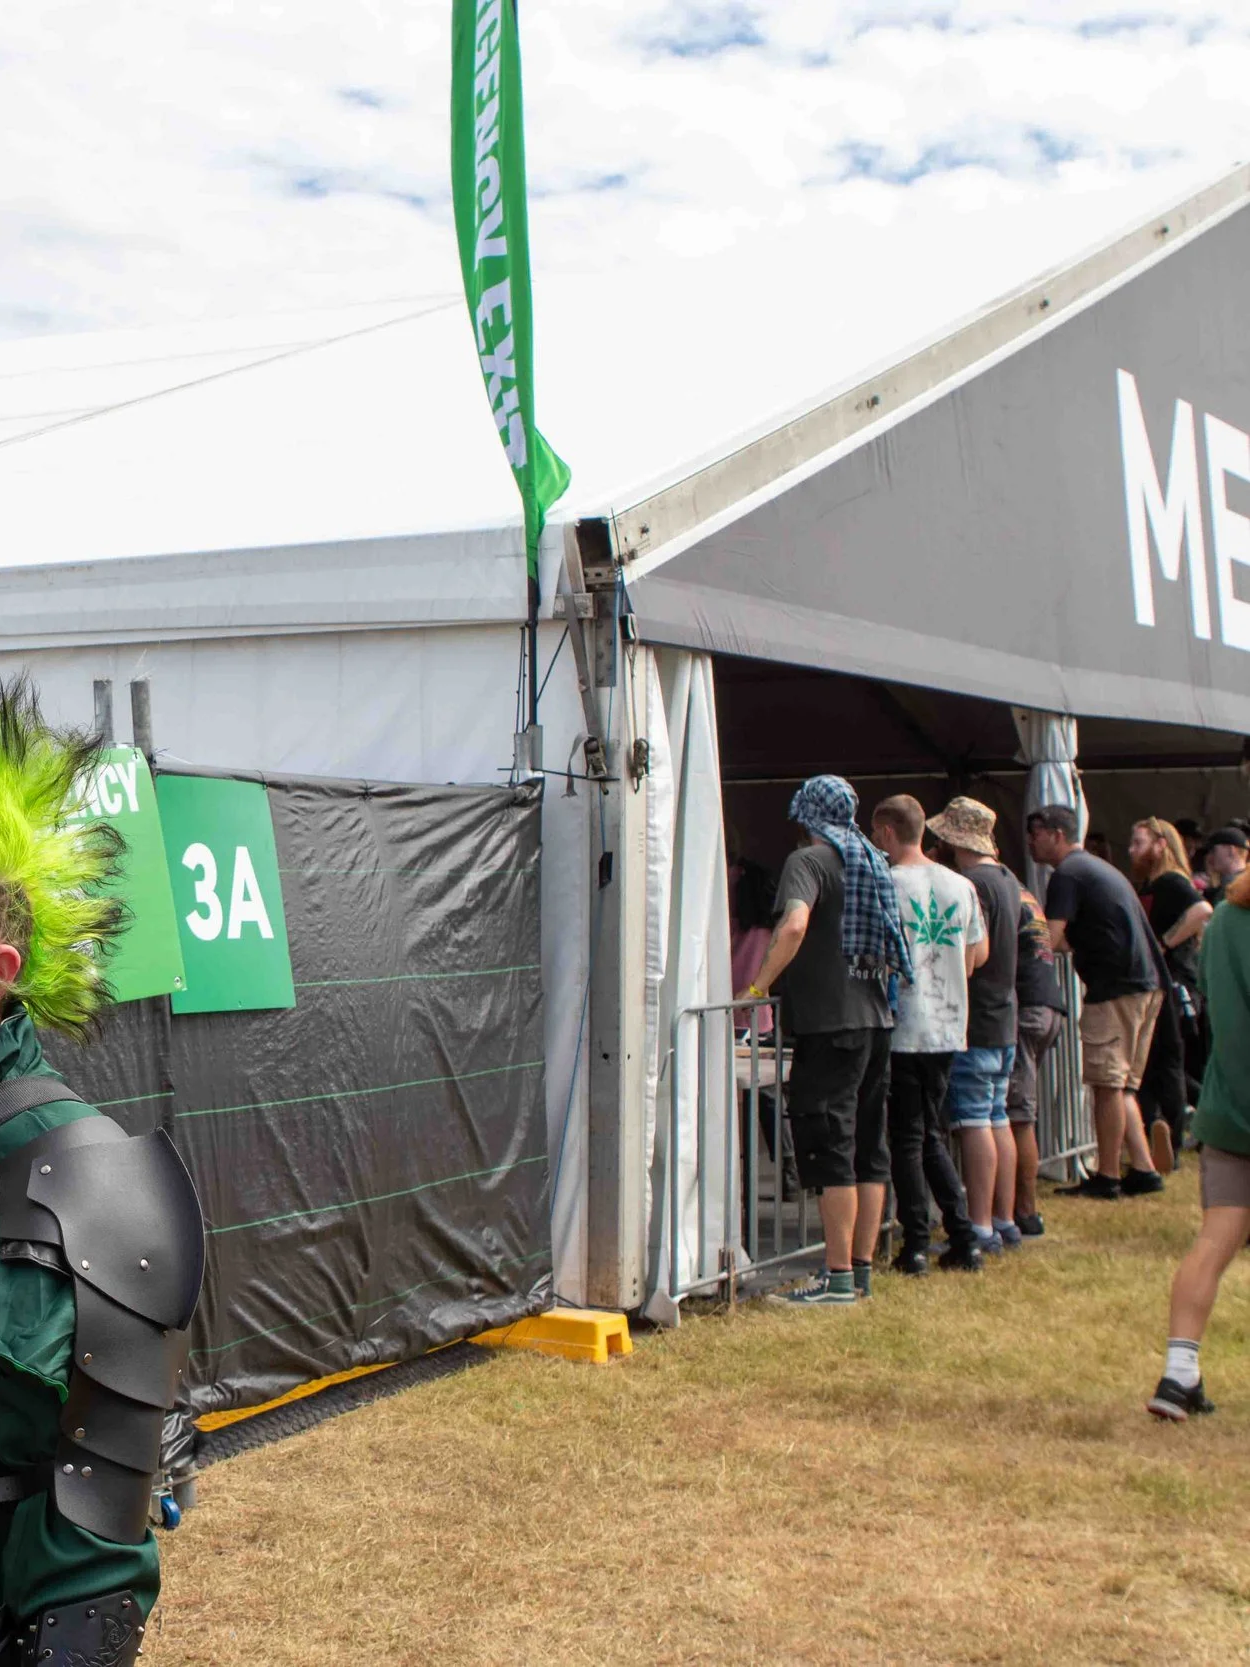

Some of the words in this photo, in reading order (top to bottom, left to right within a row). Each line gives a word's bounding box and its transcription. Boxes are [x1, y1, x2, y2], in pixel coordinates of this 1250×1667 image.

[476, 276, 528, 469] EXIT
[1116, 367, 1250, 653] ME
[181, 842, 275, 941] 3A
